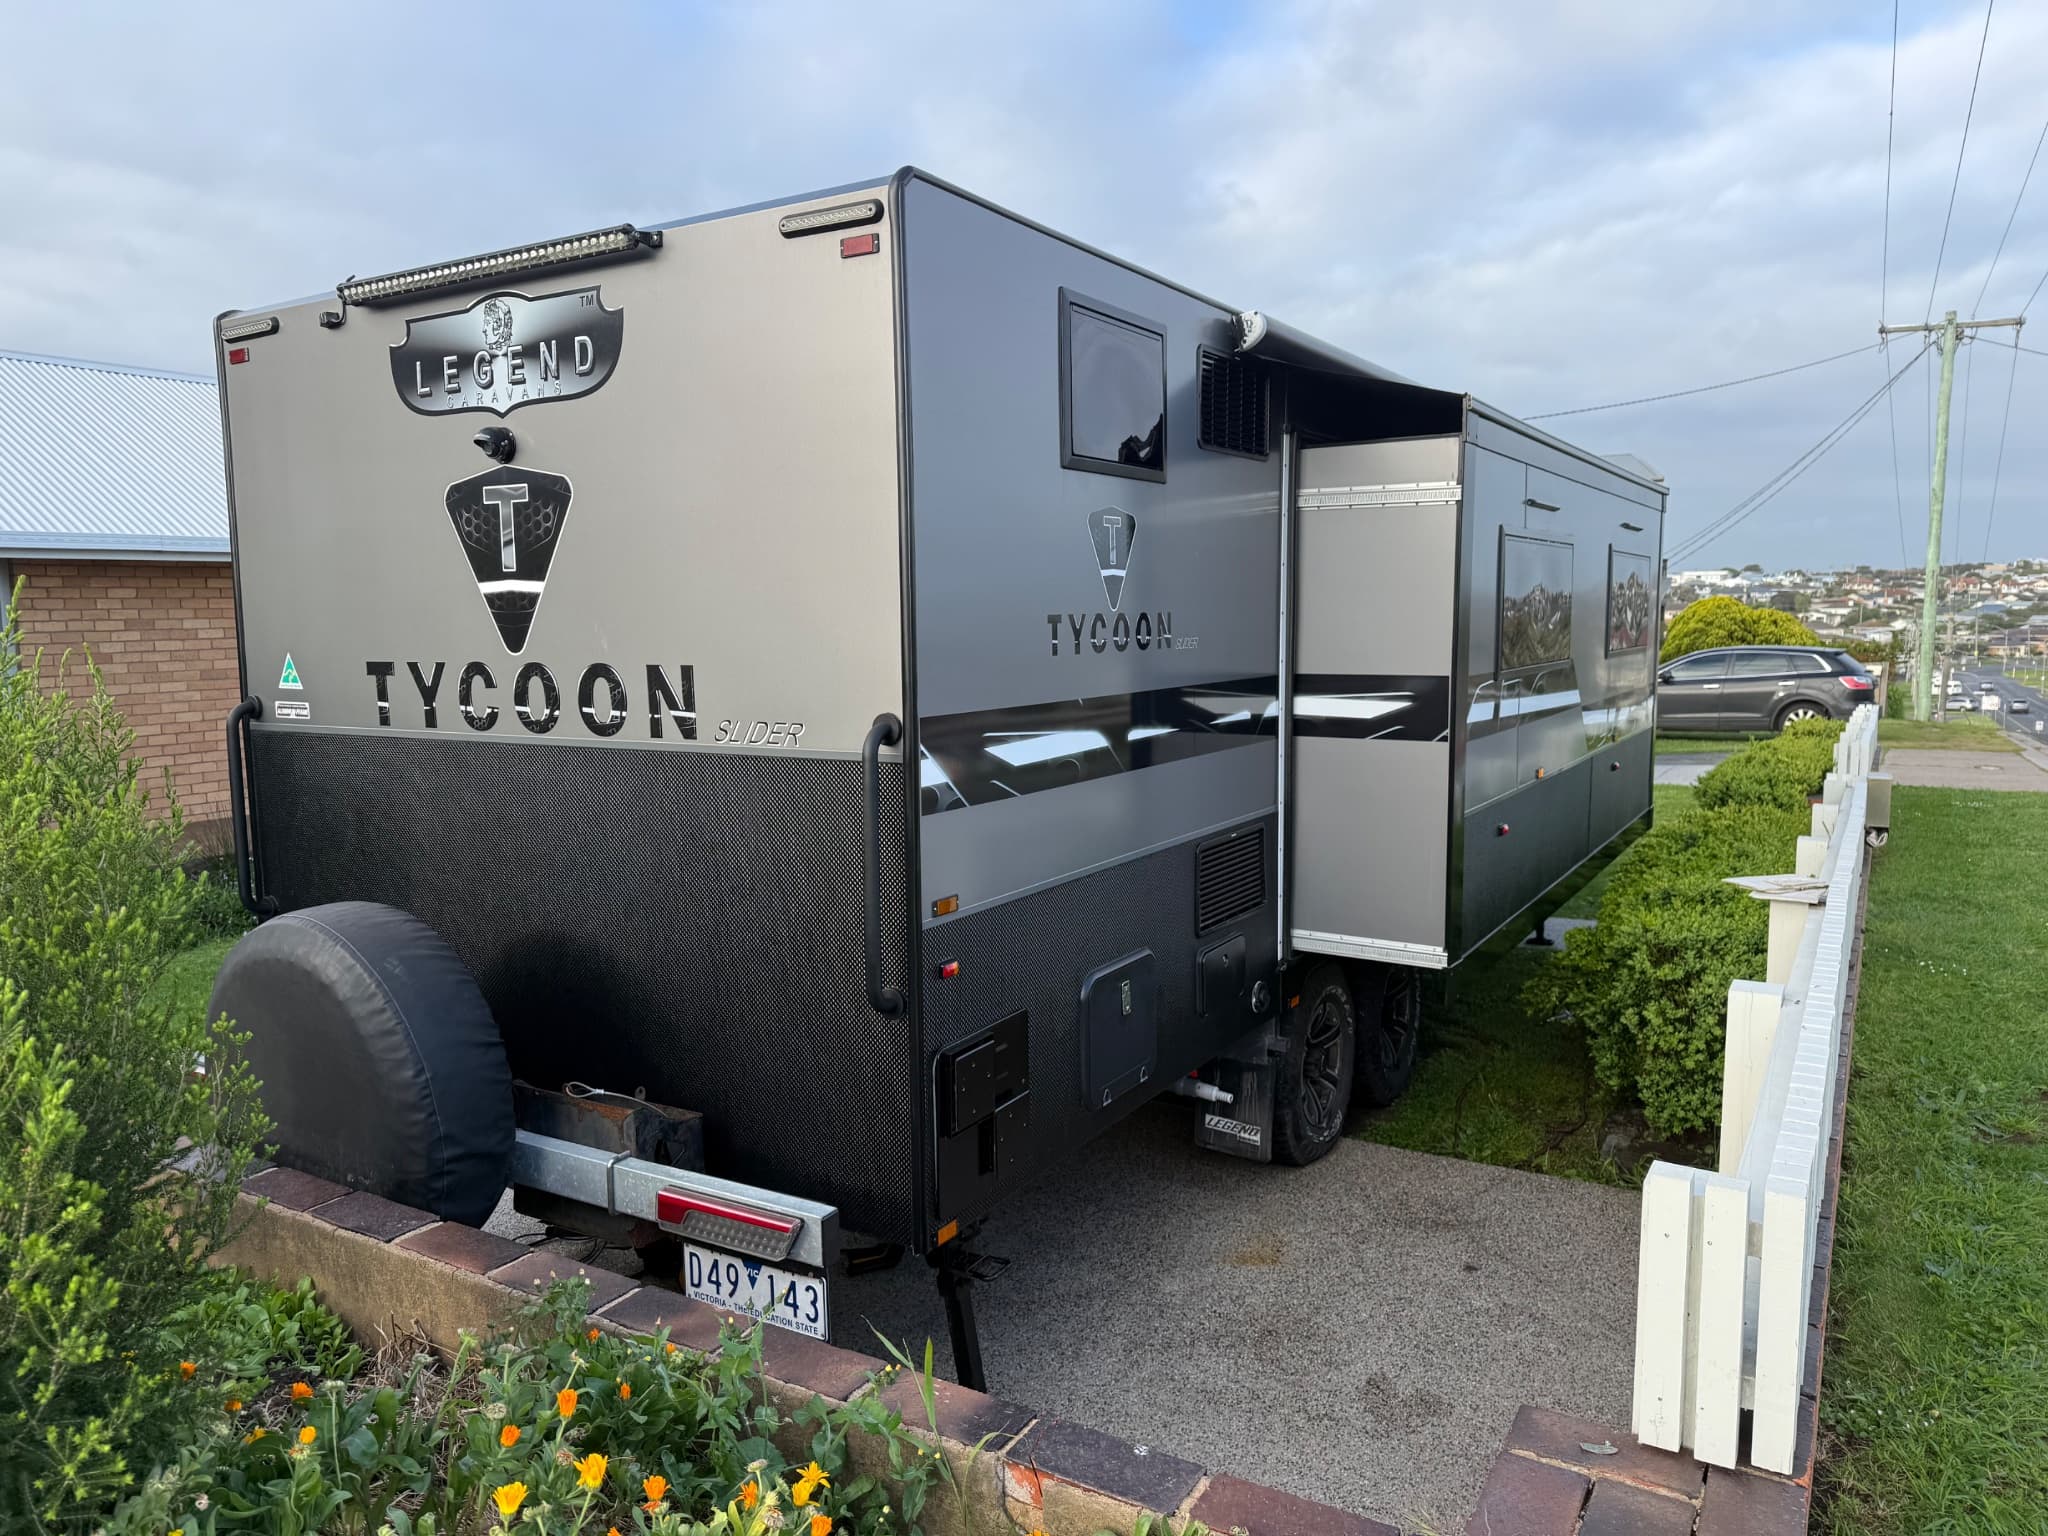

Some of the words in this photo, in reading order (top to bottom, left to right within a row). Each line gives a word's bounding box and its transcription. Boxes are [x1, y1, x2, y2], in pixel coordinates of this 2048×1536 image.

[579, 294, 594, 307] TM
[416, 335, 595, 398] LEGEND
[447, 380, 562, 409] CARAVANS
[483, 484, 528, 572] T
[1047, 611, 1173, 657] TYCOON
[366, 661, 698, 741] TYCOON
[714, 719, 806, 748] SLIDER
[1207, 1116, 1259, 1137] LEGEND
[689, 1251, 739, 1299] D49
[767, 1274, 818, 1324] 143
[693, 1290, 727, 1308] VICTORIA
[795, 1320, 819, 1335] STATE
